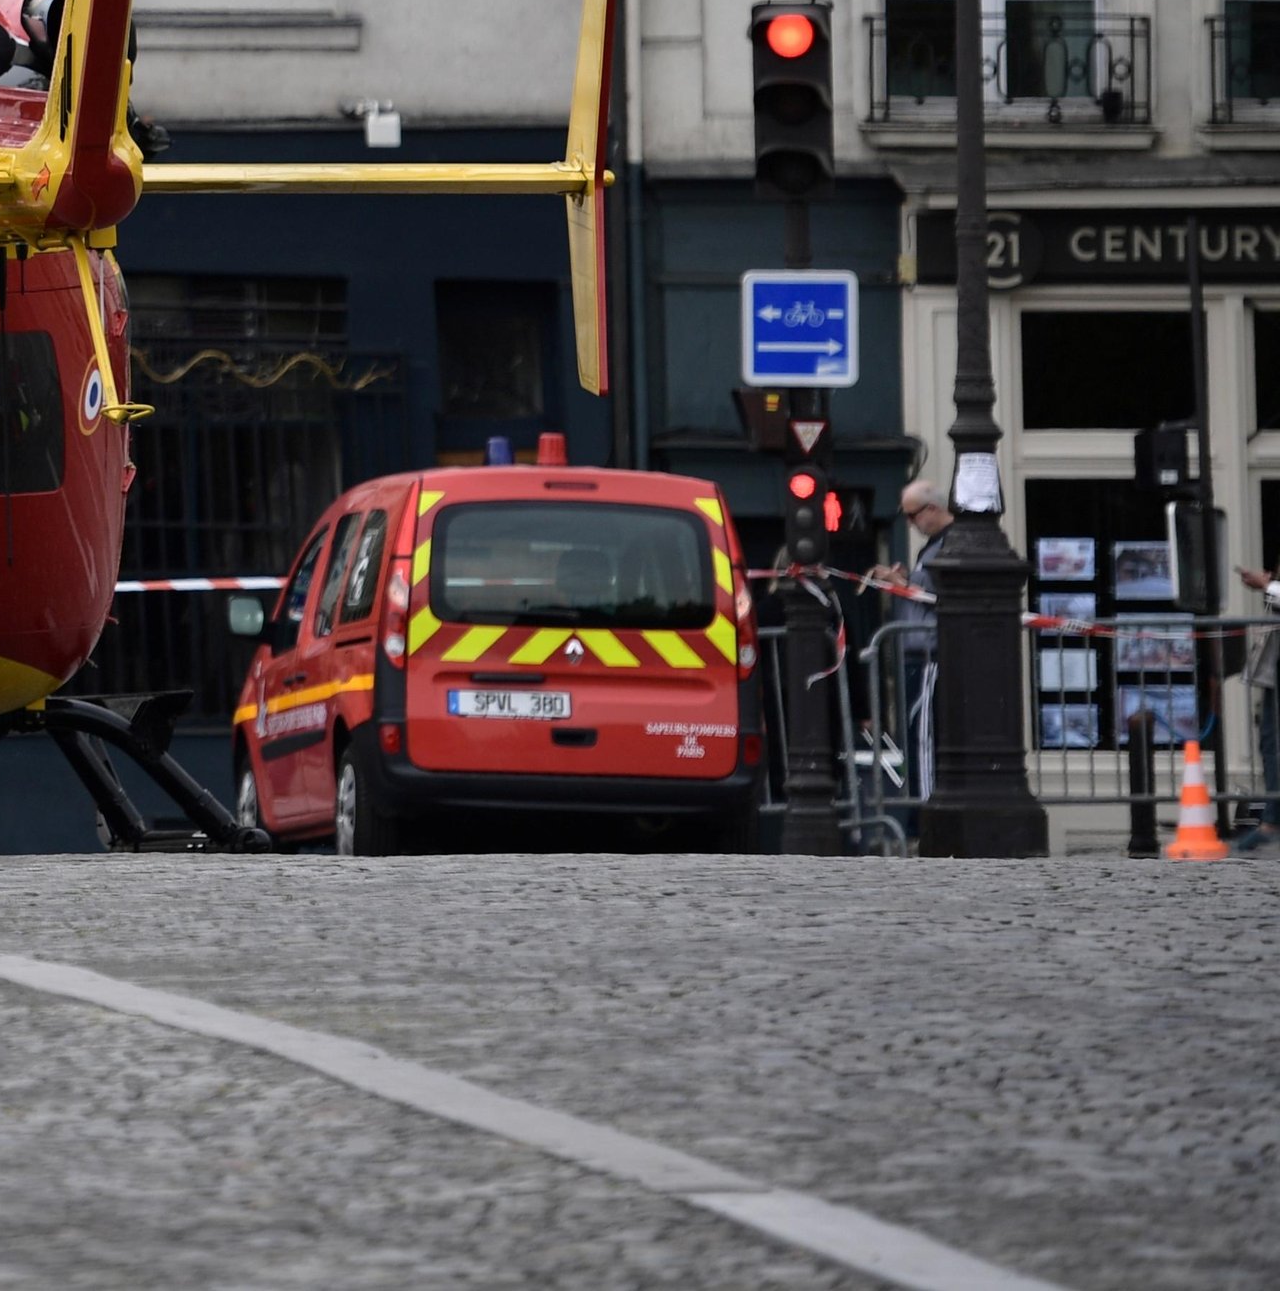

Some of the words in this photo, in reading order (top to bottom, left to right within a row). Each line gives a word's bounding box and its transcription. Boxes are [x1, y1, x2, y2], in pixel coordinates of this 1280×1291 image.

[987, 230, 1021, 269] 21
[1070, 225, 1280, 263] CENTURY
[474, 691, 518, 713] SPVL
